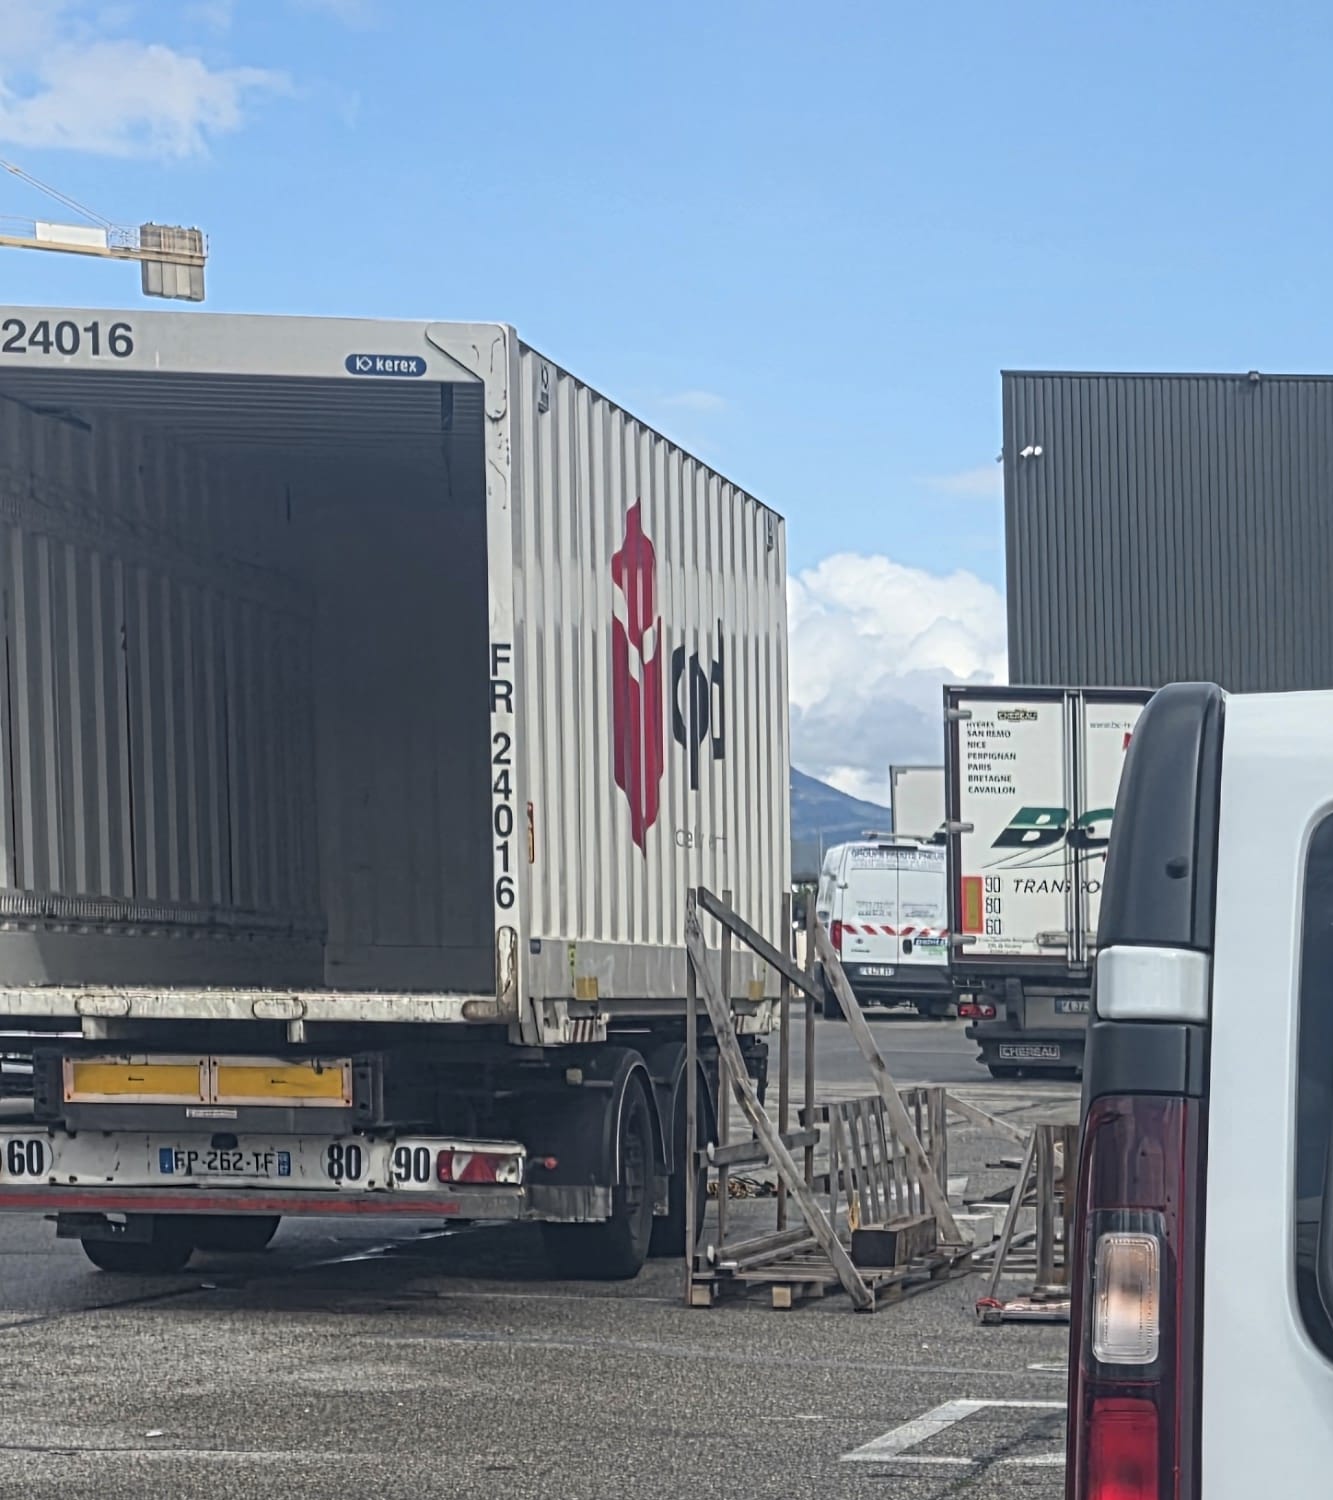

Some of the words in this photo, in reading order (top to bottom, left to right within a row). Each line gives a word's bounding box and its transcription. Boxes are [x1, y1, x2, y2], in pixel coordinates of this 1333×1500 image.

[1, 318, 135, 358] 24016
[376, 357, 417, 373] kerex
[966, 730, 985, 738] SAN
[967, 741, 987, 749] NICE
[967, 752, 1017, 761] PERPIGNAN
[967, 763, 992, 771] PARIS
[968, 774, 1012, 783] BRETAGNE
[968, 785, 1016, 794] CAVAILLON
[492, 731, 515, 910] 24016
[985, 876, 1001, 893] 90
[985, 897, 1001, 914] 80
[986, 918, 1002, 935] 60
[1001, 1045, 1058, 1057] CHEREAU
[7, 1139, 45, 1177] 60
[327, 1144, 363, 1181] 80
[395, 1147, 430, 1182] 90
